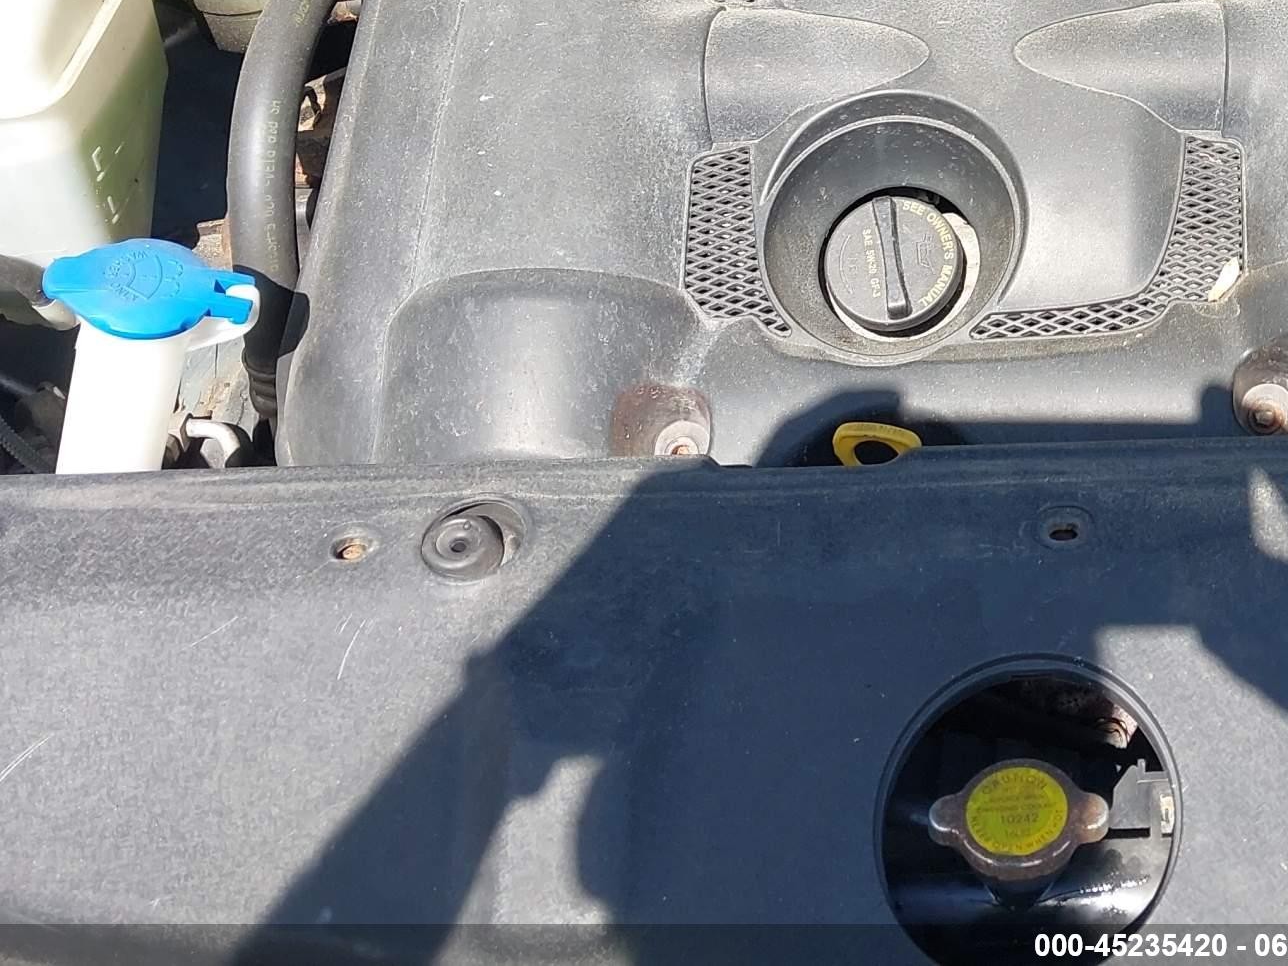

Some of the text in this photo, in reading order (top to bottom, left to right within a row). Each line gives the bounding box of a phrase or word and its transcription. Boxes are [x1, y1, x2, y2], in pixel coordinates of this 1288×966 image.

[862, 228, 873, 246] SAE
[865, 249, 878, 275] 5W-20
[902, 201, 955, 307] SEE OWNER'S MANUAL
[982, 774, 1049, 795] CAUTION
